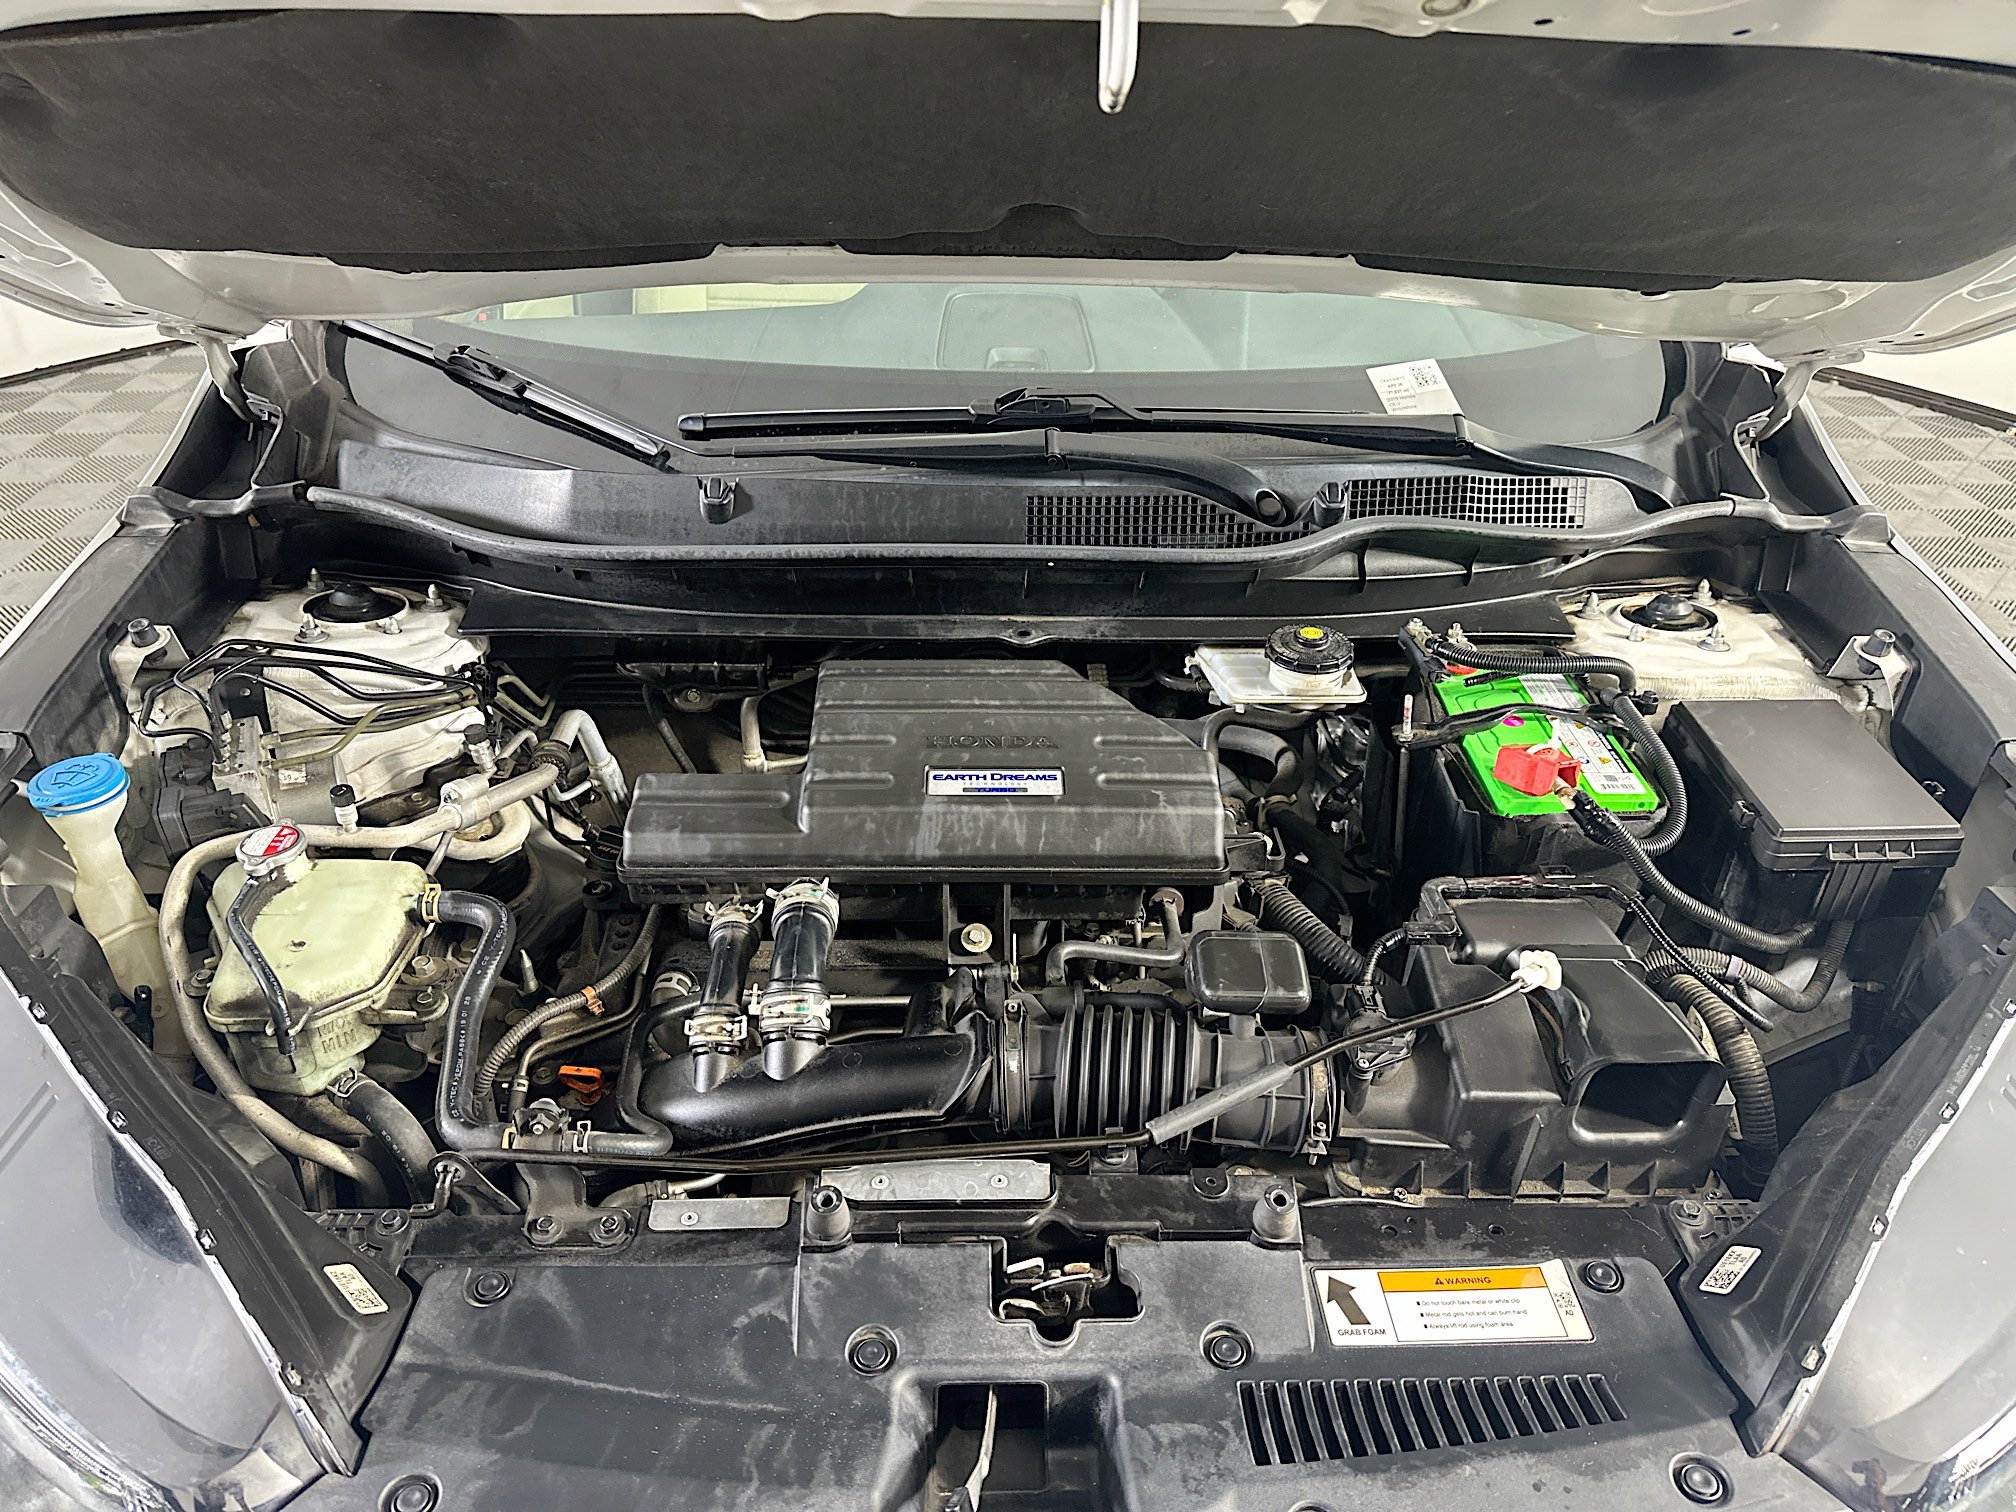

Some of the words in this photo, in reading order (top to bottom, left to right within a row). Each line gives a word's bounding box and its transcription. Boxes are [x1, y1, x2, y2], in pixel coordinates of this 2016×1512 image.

[926, 736, 1058, 748] HONDA
[317, 1014, 352, 1037] MAX
[322, 1028, 356, 1054] MIN
[1445, 1277, 1492, 1285] WARNING
